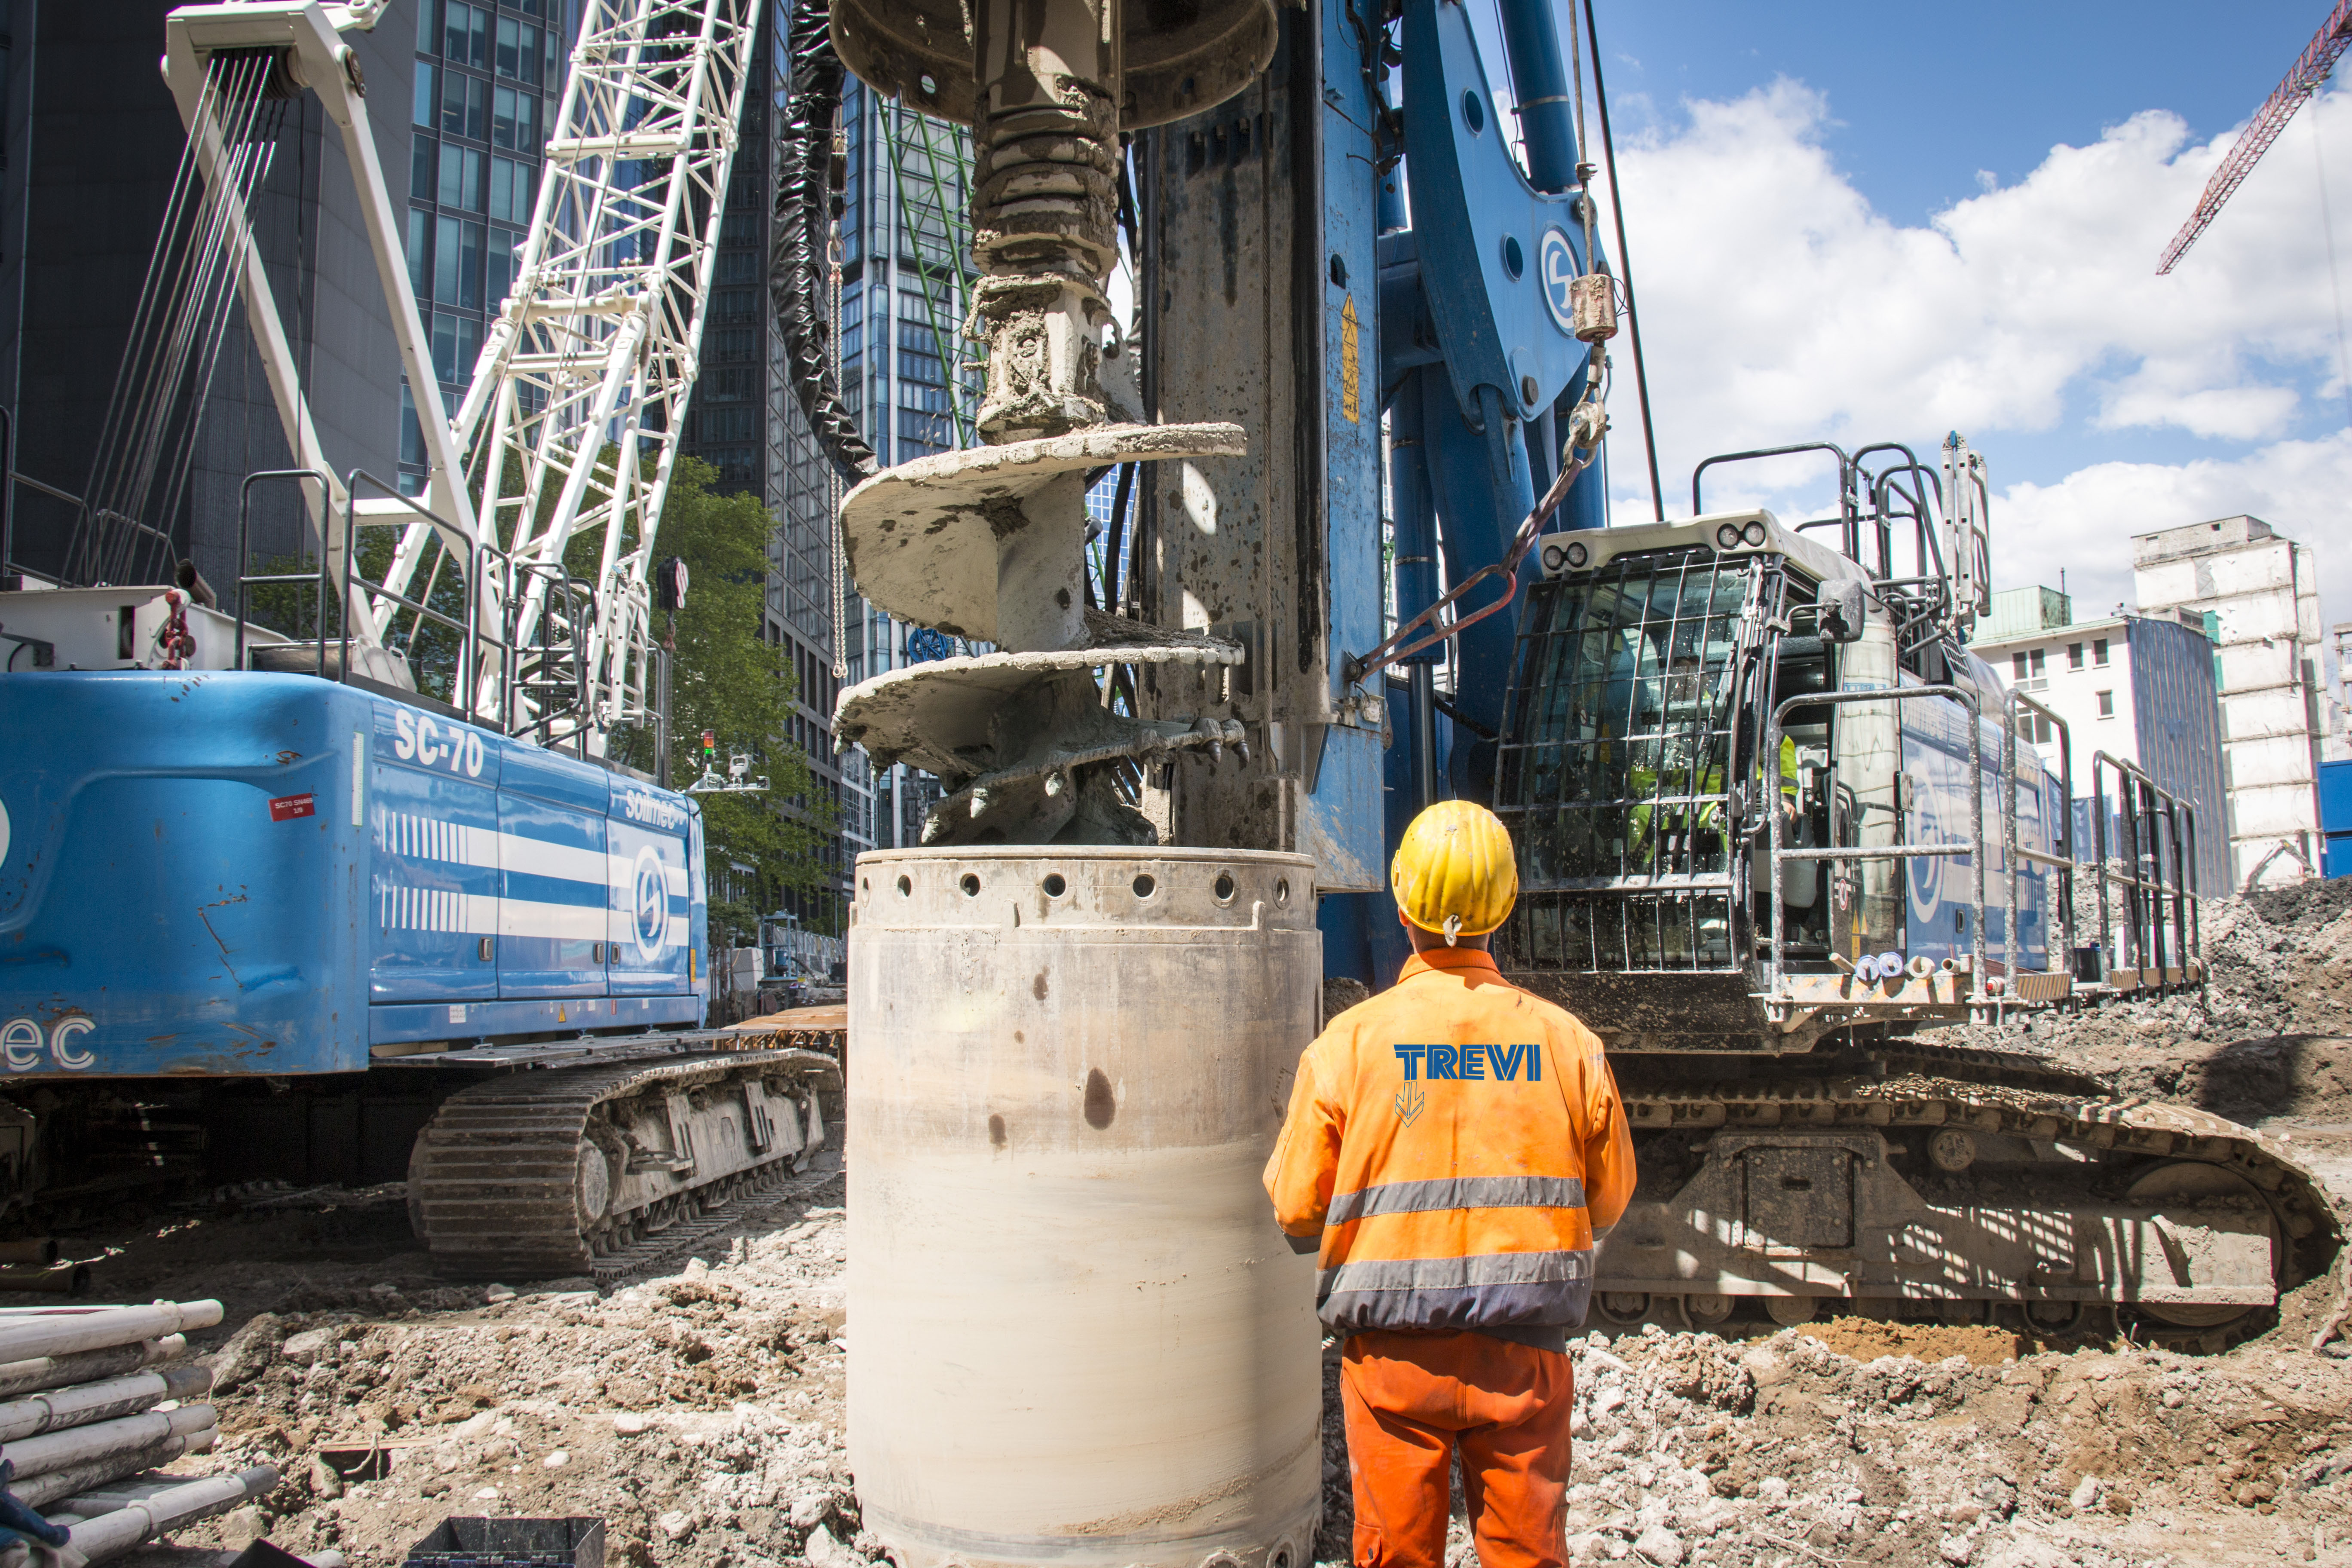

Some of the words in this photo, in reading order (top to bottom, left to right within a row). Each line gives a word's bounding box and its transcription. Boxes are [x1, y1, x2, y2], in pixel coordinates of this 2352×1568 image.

[395, 709, 484, 778] SC-70
[275, 801, 292, 809] SC70
[626, 785, 675, 830] soilmec
[0, 1018, 96, 1071] ec
[1393, 1044, 1541, 1081] TREVI
